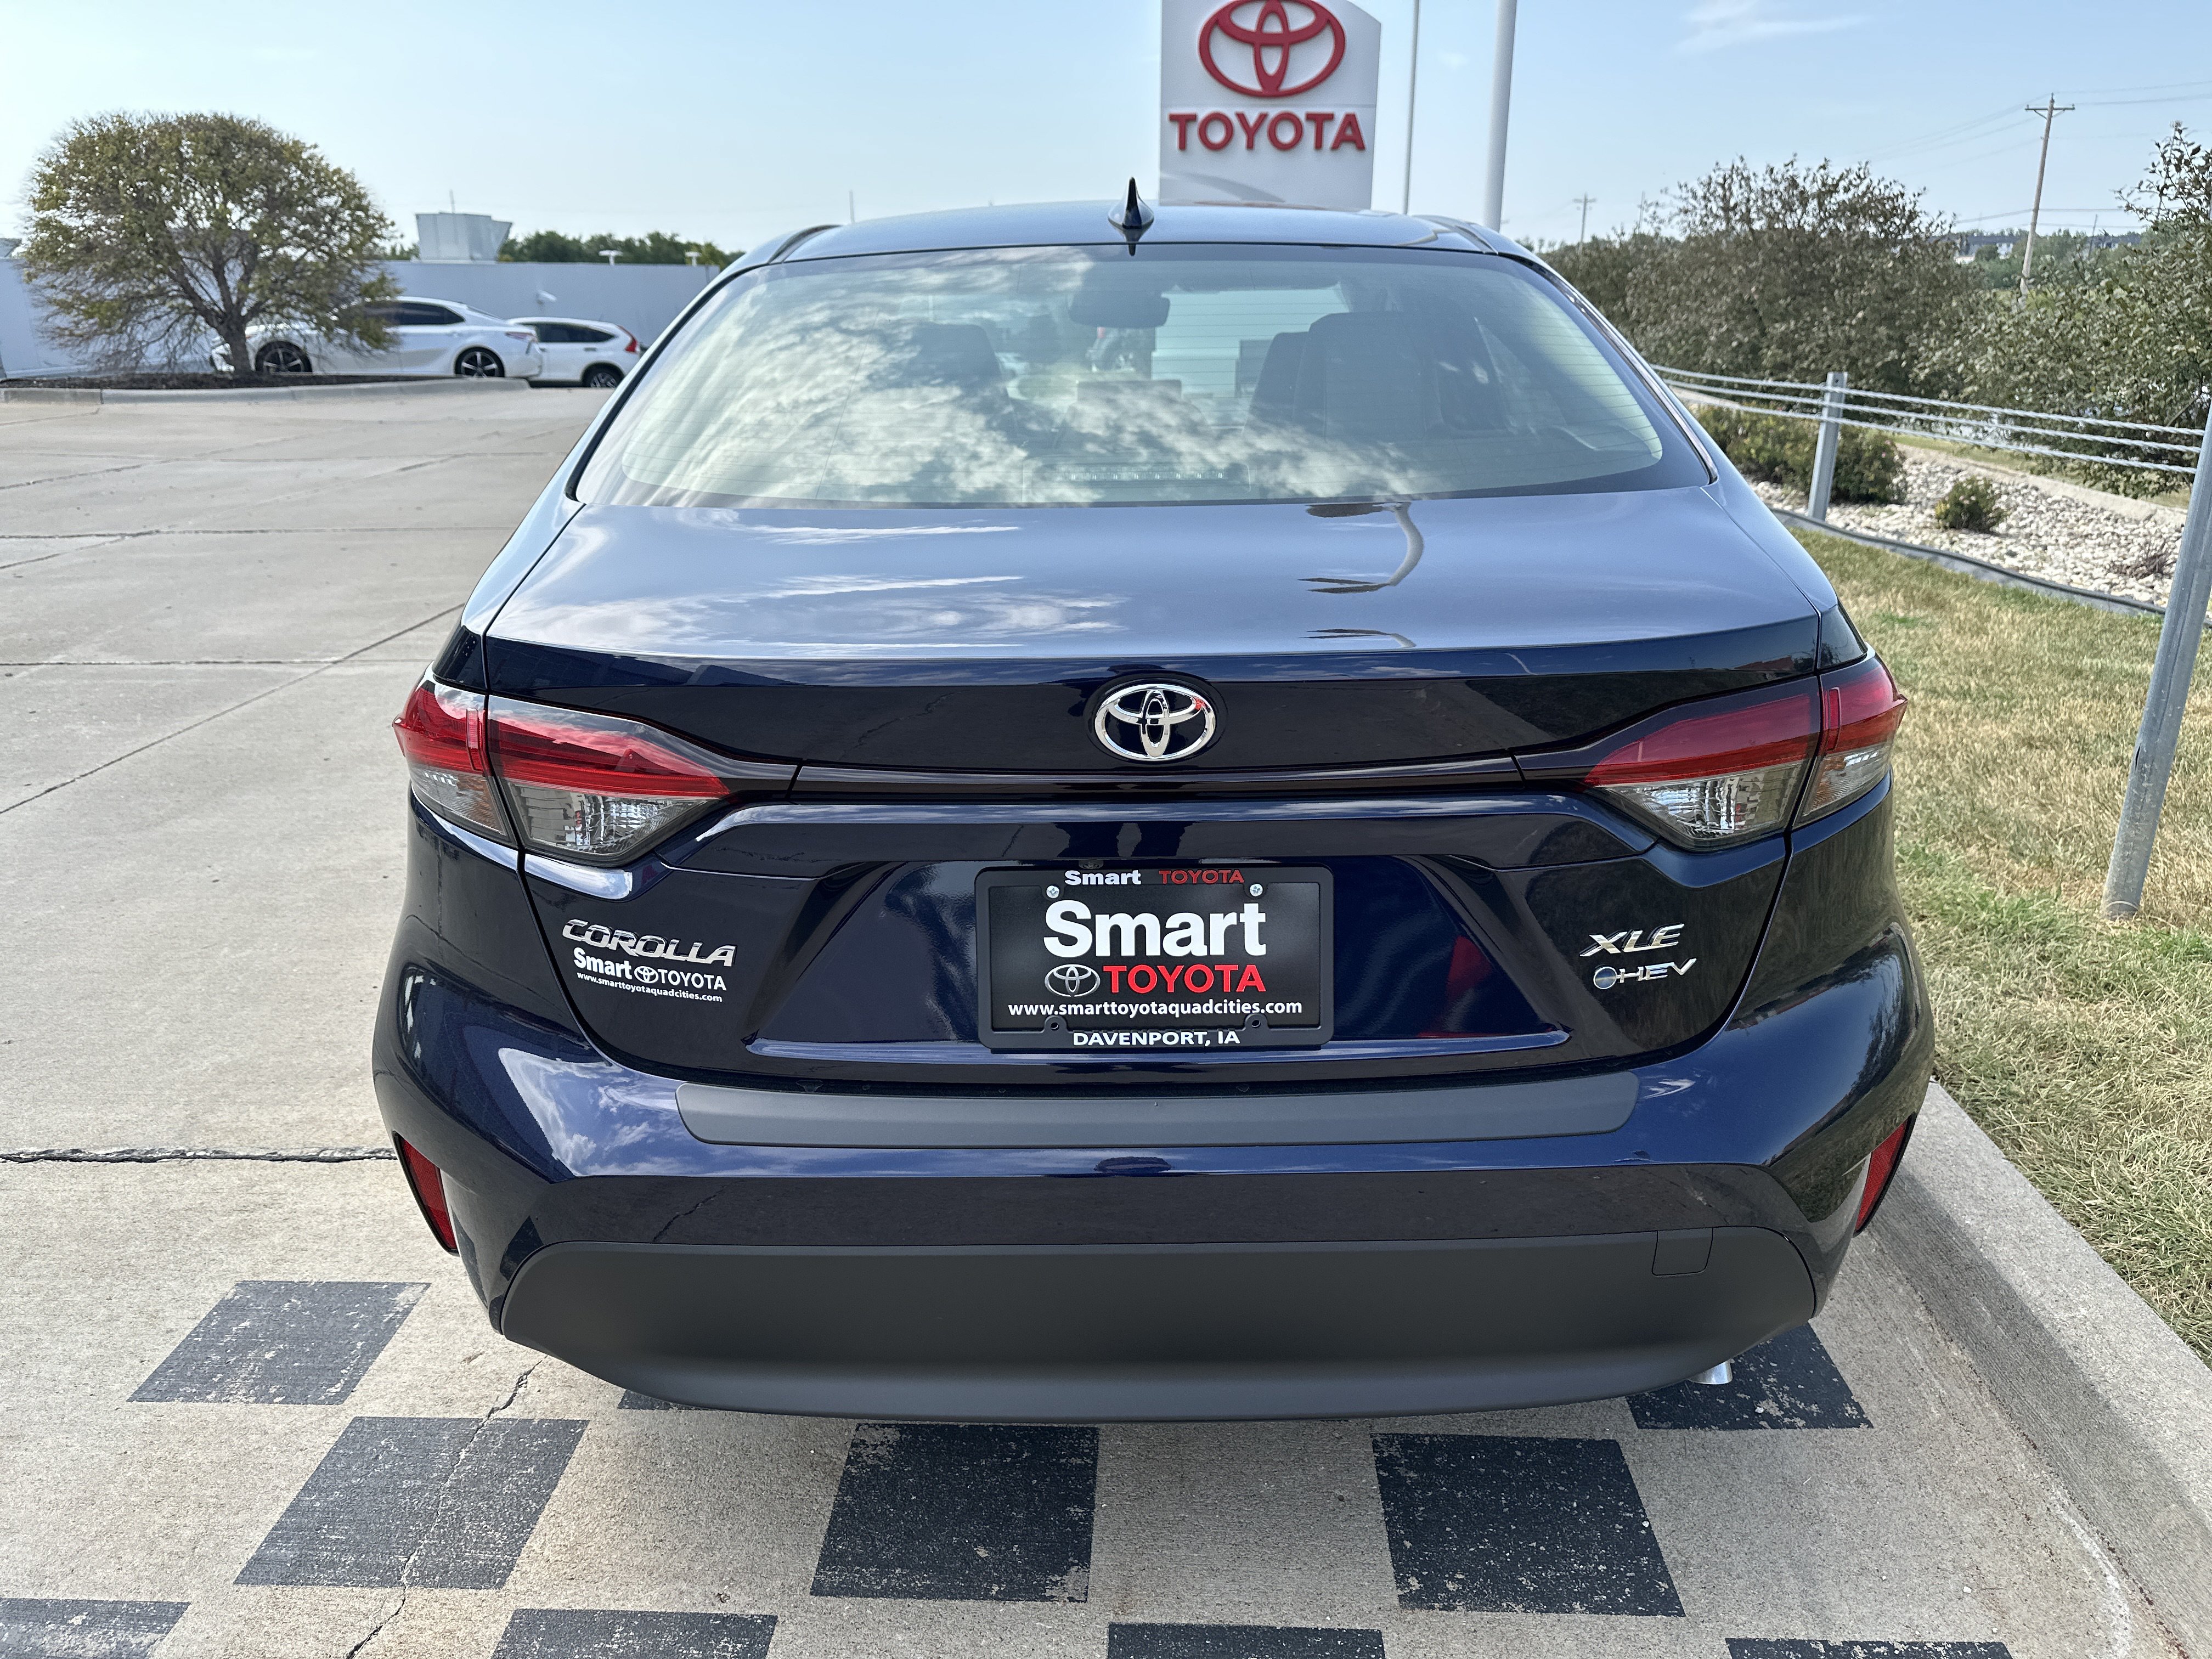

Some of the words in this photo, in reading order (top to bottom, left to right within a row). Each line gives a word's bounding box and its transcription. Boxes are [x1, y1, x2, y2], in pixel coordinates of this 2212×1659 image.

[1169, 112, 1365, 151] TOYOTA
[1064, 870, 1142, 885] Smart
[1158, 870, 1245, 884] TOYOTA
[562, 919, 737, 967] COROLLA
[1043, 900, 1266, 958] Smart
[1579, 923, 1685, 957] XLE
[573, 947, 633, 979] Smart
[658, 969, 727, 991] TOYOTA
[1103, 964, 1266, 994] TOYOTA
[577, 971, 723, 1002] www.smarttoyotaquadcities.com
[1008, 998, 1302, 1019] www.smarttoyotaquadcities.com
[1073, 1031, 1211, 1047] DAVENPORT,
[1217, 1030, 1240, 1044] IA
